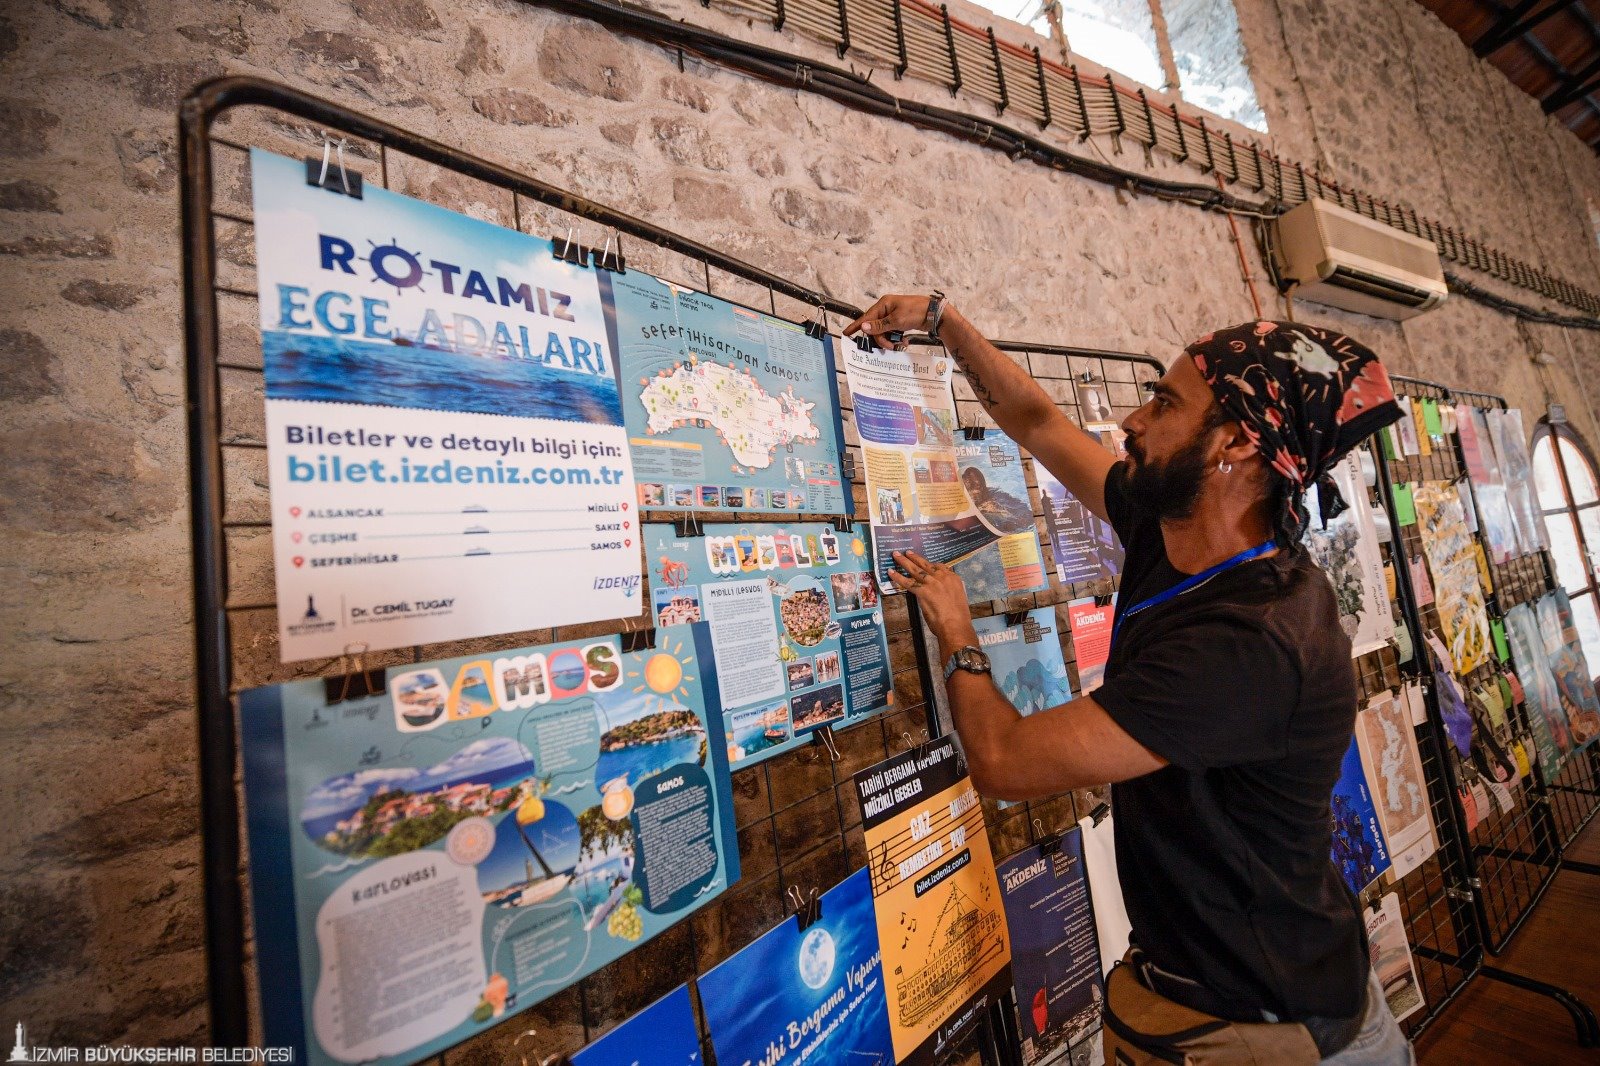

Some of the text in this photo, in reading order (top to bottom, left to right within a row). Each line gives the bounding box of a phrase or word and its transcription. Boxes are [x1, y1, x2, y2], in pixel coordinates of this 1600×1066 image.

[318, 233, 576, 322] ROTAMIZ
[276, 283, 606, 374] EGE ADALARI
[851, 349, 863, 363] The
[912, 362, 929, 374] Post
[285, 425, 622, 459] Biletler ve detaylı bilgi için:
[288, 455, 624, 486] bilet.izdeniz.com.tr
[307, 508, 384, 519] ALSANCAK
[588, 503, 619, 512] MİDİLLİ
[307, 531, 358, 544] ÇEŞME
[595, 523, 620, 531] SAKIZ
[310, 553, 399, 568] SEFERİHİSAR
[591, 542, 622, 550] SAMOS
[593, 574, 640, 589] İZDENİZ
[351, 598, 455, 618] Dr. CEMİL TUGAY
[978, 627, 1019, 646] AKDENİZ
[396, 643, 621, 729] SAMOS
[859, 771, 885, 798] TARİHİ
[884, 760, 917, 786] BERGAMA
[864, 778, 923, 819] MÜZİKLİ GECELER
[910, 787, 977, 841] CAZ AKUSTİK
[899, 825, 966, 880] REMBETİKO POP
[1006, 859, 1047, 892] AKDENİZ
[742, 950, 881, 1066] ihi Bergama Vapuru
